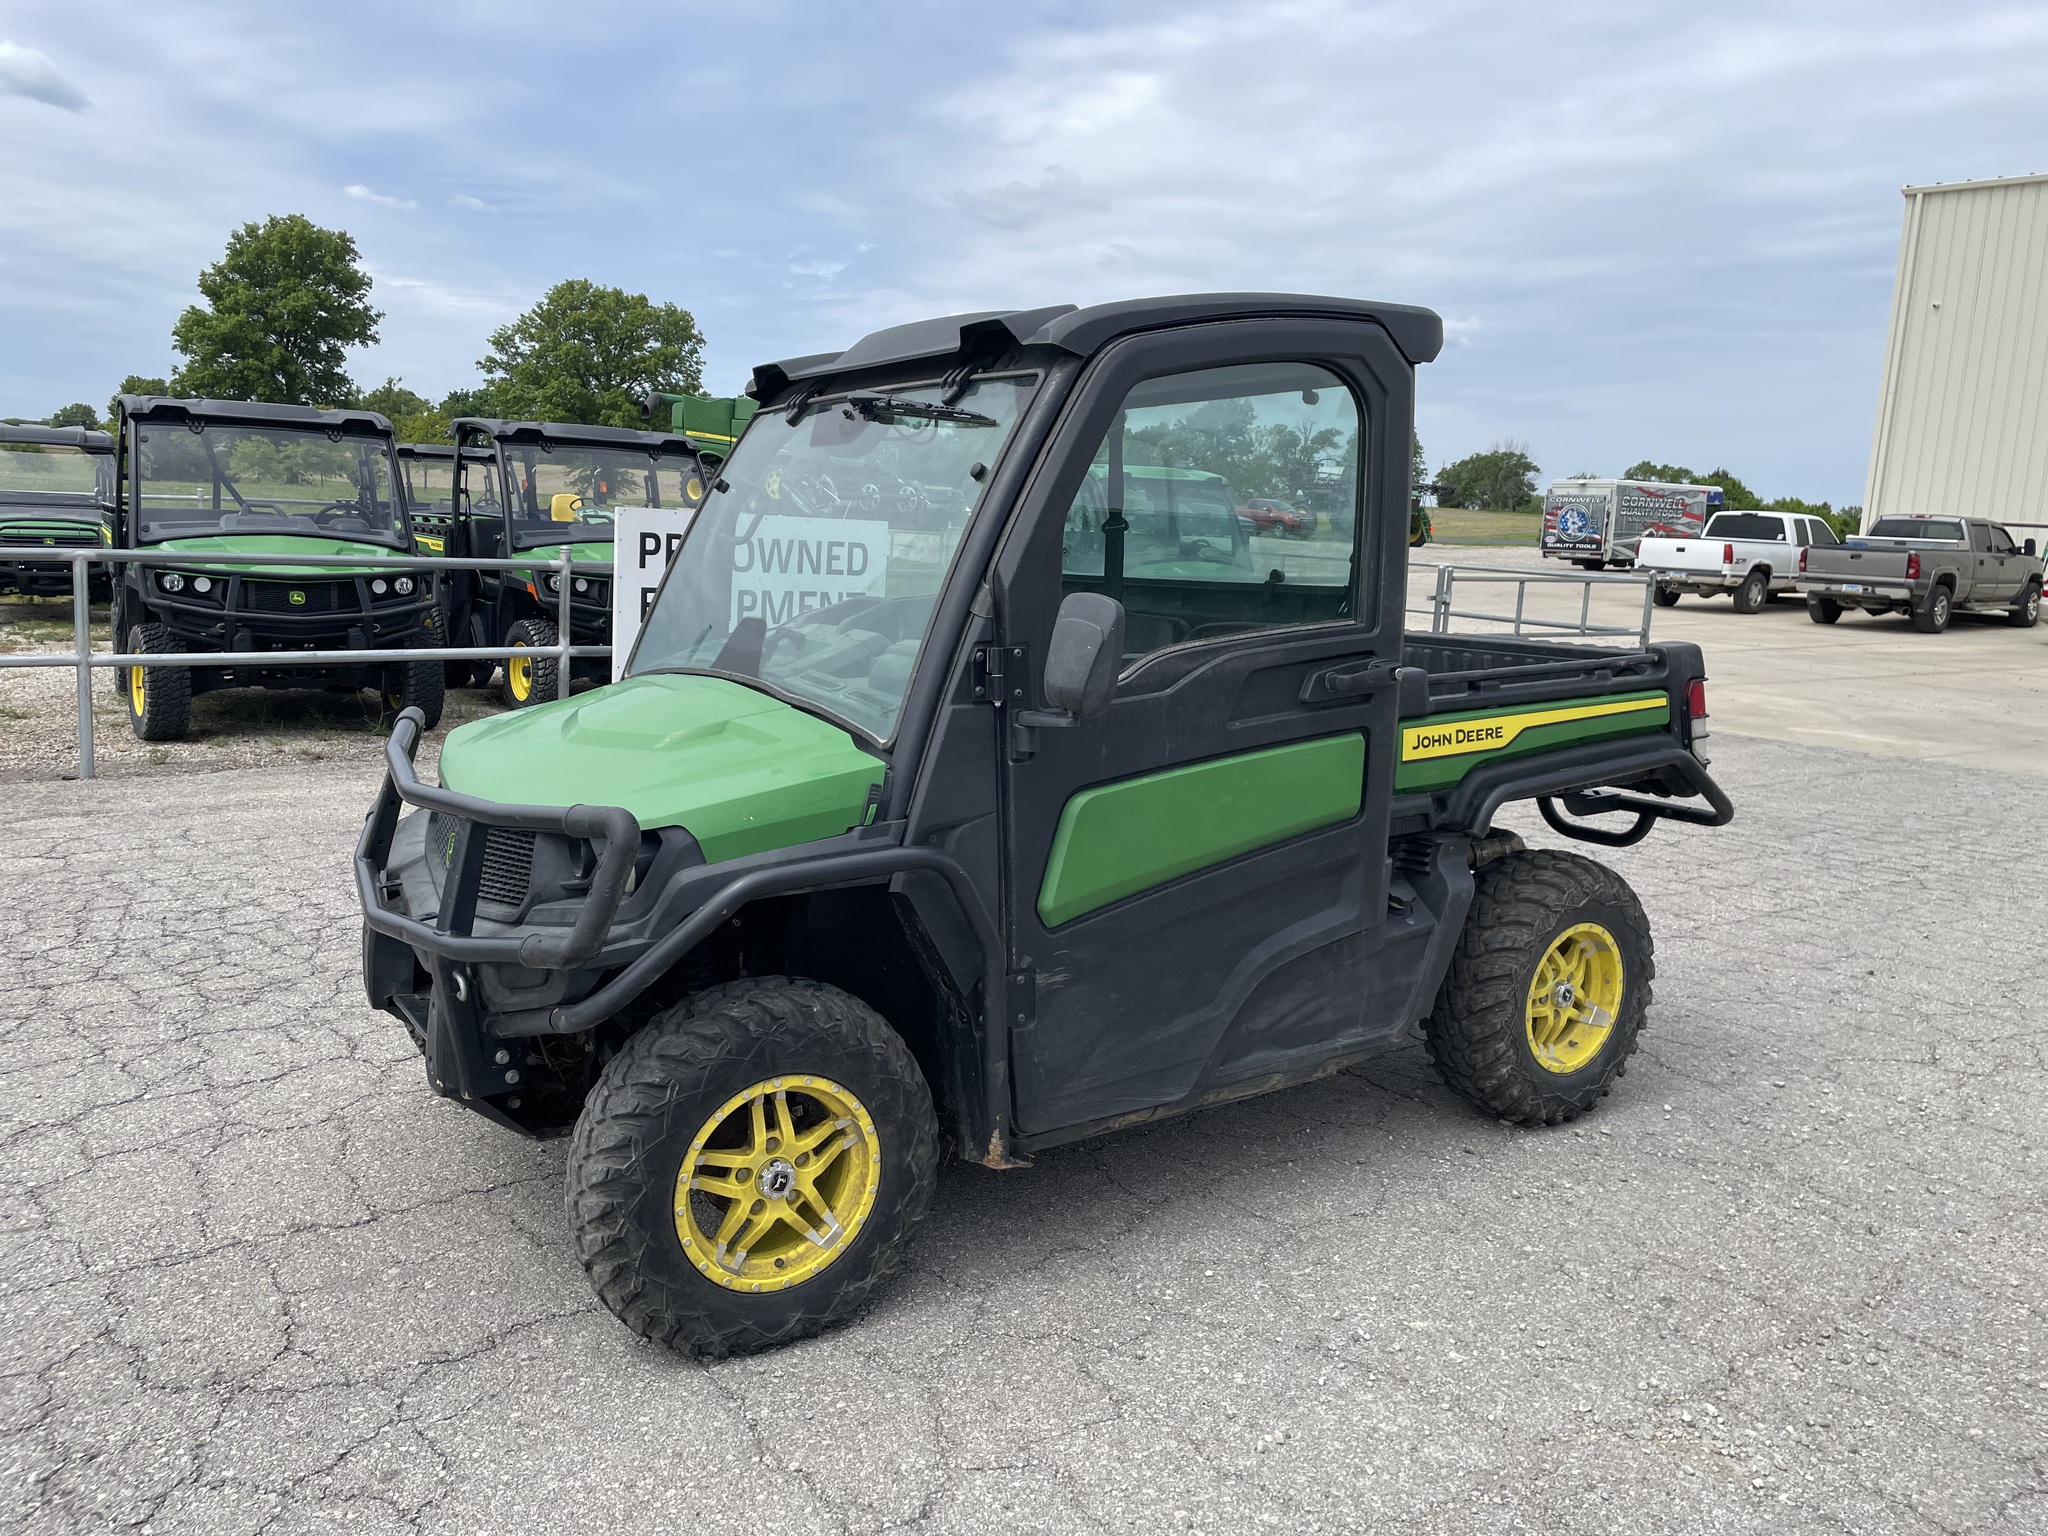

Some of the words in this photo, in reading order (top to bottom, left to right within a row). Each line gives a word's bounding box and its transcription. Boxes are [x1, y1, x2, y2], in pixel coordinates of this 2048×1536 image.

[1622, 496, 1684, 509] CORNWELL
[1620, 507, 1656, 517] QUALITY
[1658, 509, 1683, 518] TOOLS
[1412, 733, 1452, 750] JOHN
[1455, 726, 1503, 744] DEERE
